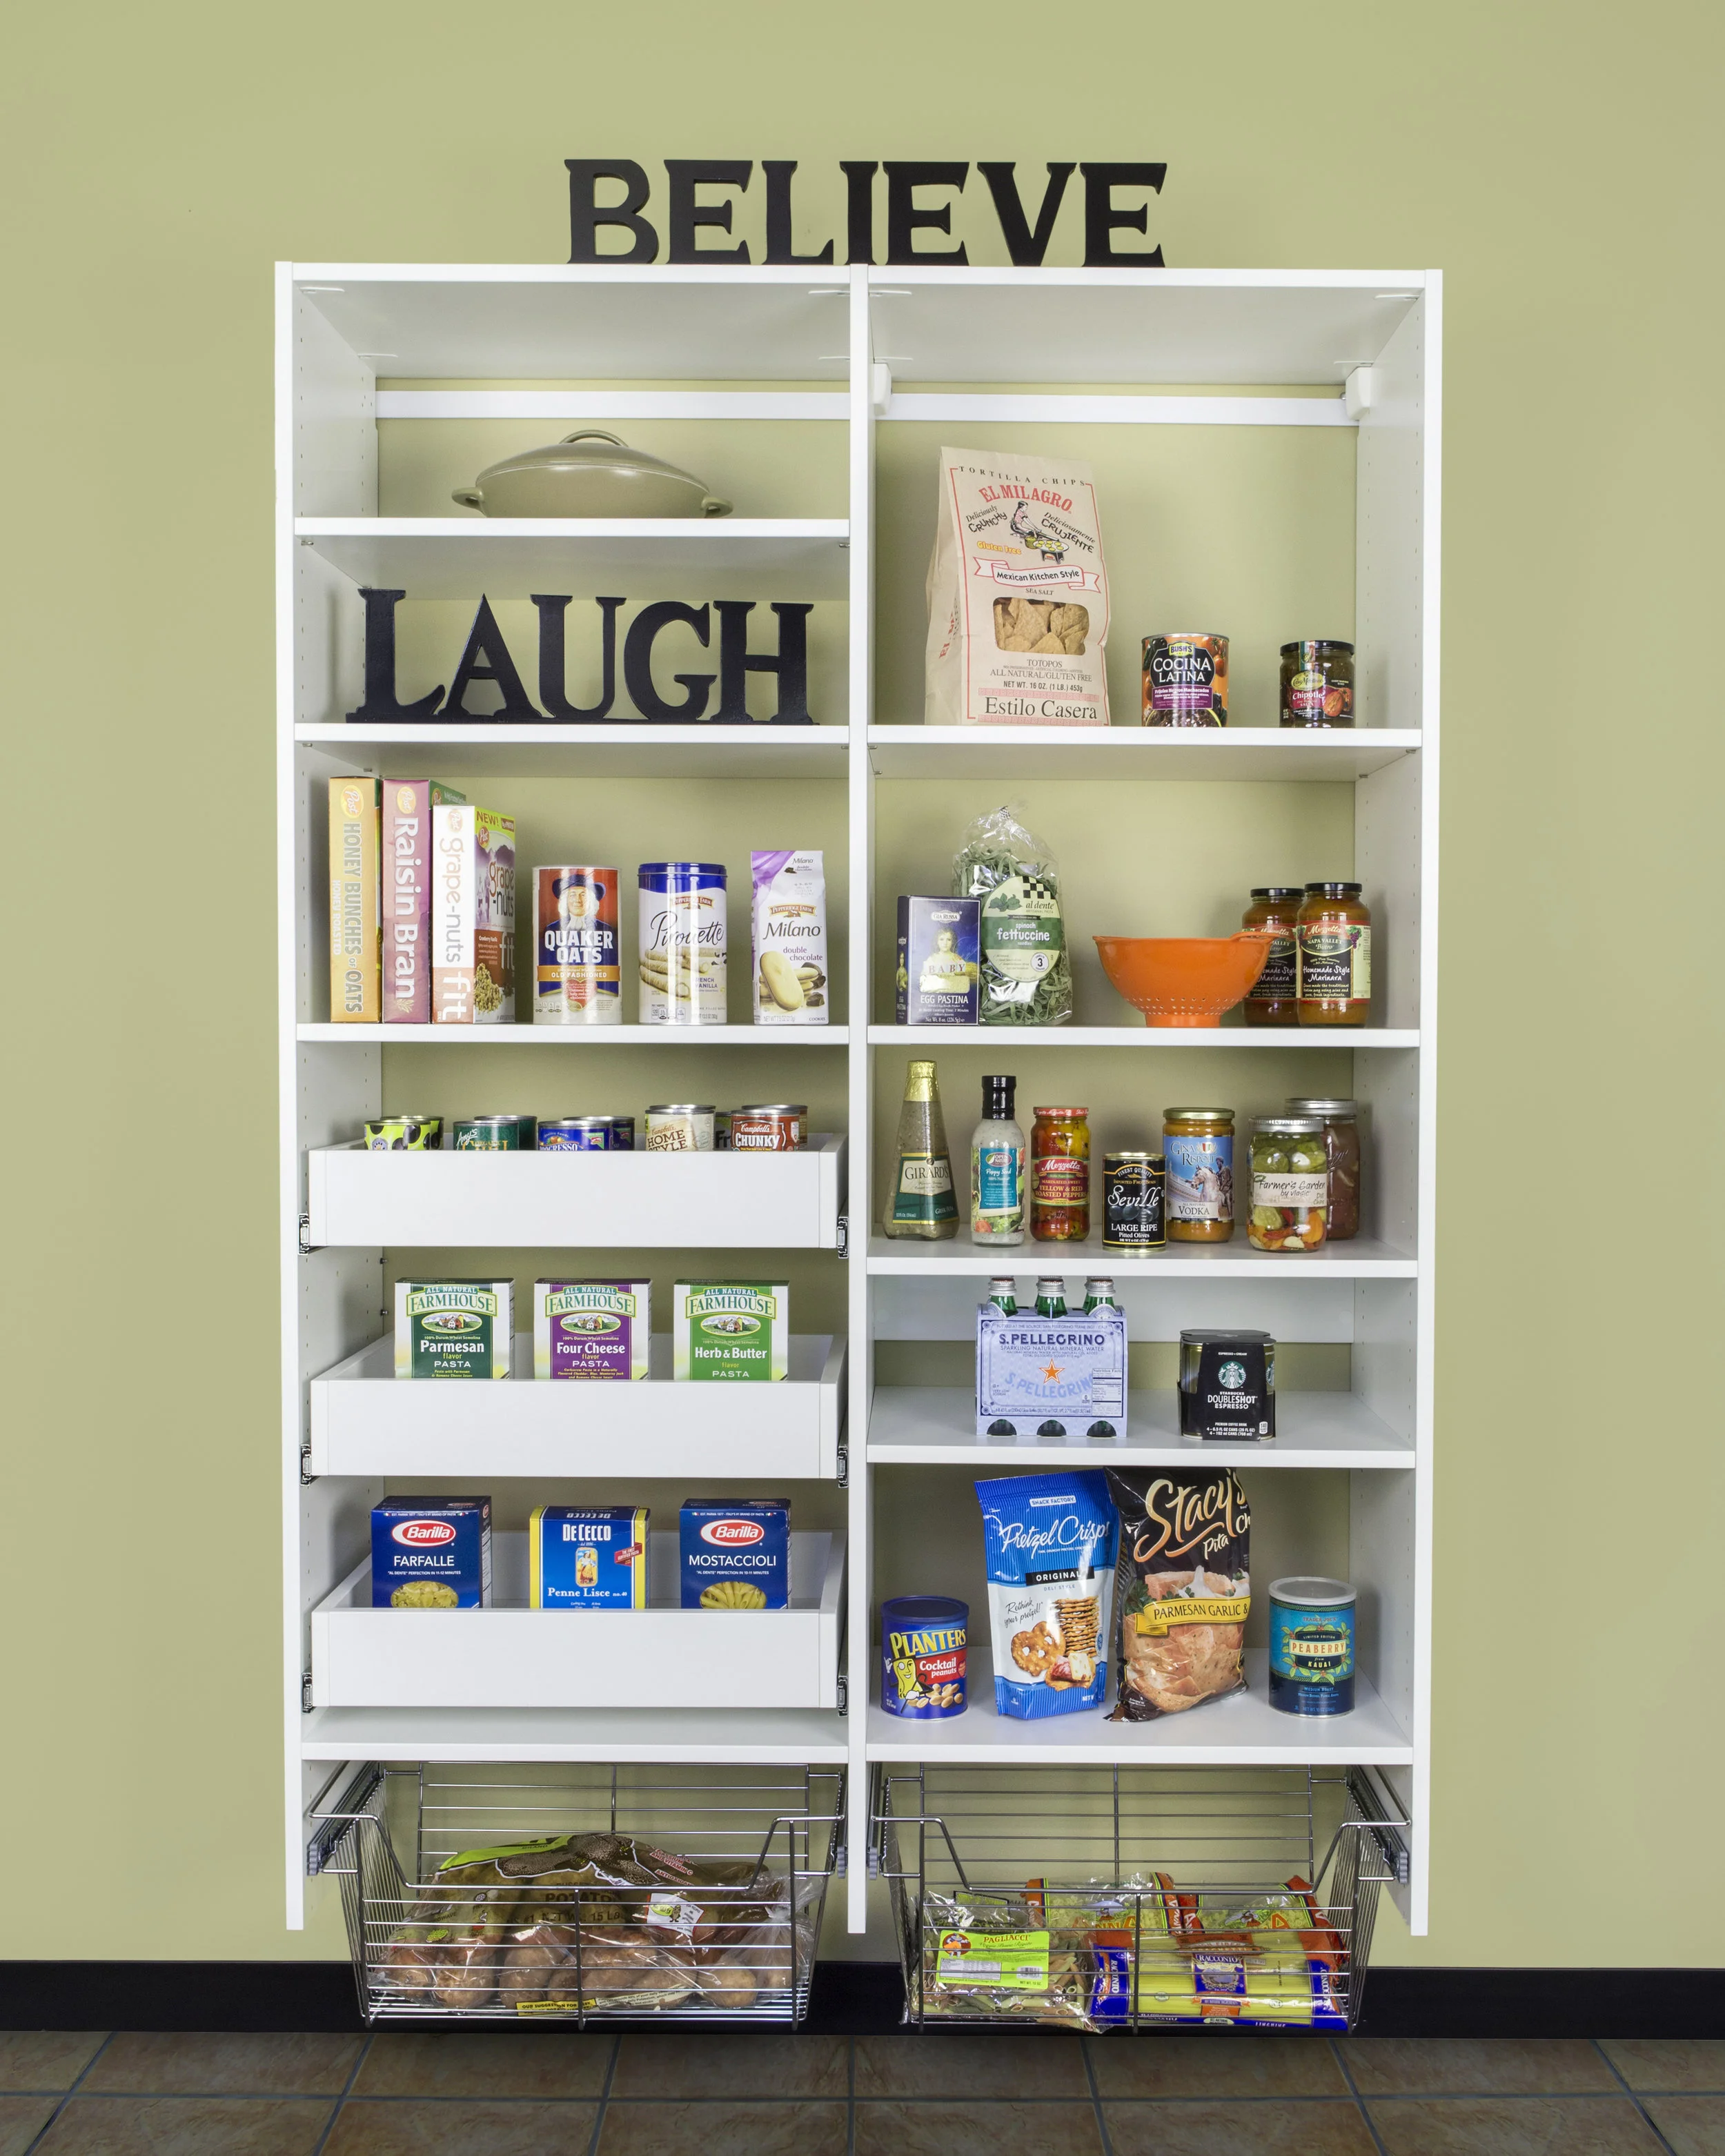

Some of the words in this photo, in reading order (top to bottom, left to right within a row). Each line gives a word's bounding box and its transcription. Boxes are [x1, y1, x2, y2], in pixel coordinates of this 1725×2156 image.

[564, 159, 1167, 266] BELIEVE
[959, 466, 1031, 483] TORTILLA
[1042, 477, 1085, 486] CHIPS
[979, 486, 1000, 503] EL
[999, 485, 1073, 512] MILAGRO
[966, 505, 998, 523] Deliciously
[968, 512, 1007, 533] CRUNCHY
[1044, 512, 1096, 543] Deliciosamente
[1041, 519, 1094, 553] CRUJIENTE
[977, 541, 1003, 551] Gluten
[1005, 546, 1021, 555] Free
[997, 572, 1028, 581] Mexican
[1029, 571, 1059, 581] Kitchen
[1061, 571, 1080, 580] Style
[346, 589, 820, 725] LAUGH
[1027, 660, 1063, 668] TOTOPOS
[1154, 657, 1212, 672] COCINA
[1159, 671, 1205, 682] LATINA
[1292, 691, 1323, 700] Chipotle
[985, 697, 1036, 715] Estilo
[1041, 700, 1097, 720] Casera
[345, 791, 360, 814] Post
[477, 811, 499, 827] NEW!
[480, 828, 489, 843] Post
[344, 822, 362, 878] HONEY
[394, 817, 422, 916] Raisin
[489, 861, 514, 897] grape
[440, 837, 465, 963] grape-nuts
[1034, 900, 1054, 909] dente
[344, 882, 363, 956] BUNCHES
[762, 921, 821, 940] Milano
[996, 927, 1050, 941] fettuccine
[1308, 924, 1343, 935] Mezzetta
[544, 930, 613, 951] QUAKER
[394, 924, 418, 999] Bran
[556, 947, 602, 963] OATS
[348, 958, 356, 968] OF
[929, 964, 965, 974] BABY
[1037, 958, 1043, 967] 3
[1303, 965, 1332, 973] Homemade
[1334, 965, 1350, 975] Style
[1308, 973, 1342, 982] Marinara
[344, 970, 363, 1013] OATS
[442, 970, 471, 1020] fit
[920, 996, 935, 1004] EGG
[937, 995, 969, 1004] PASTINA
[741, 1123, 771, 1134] Campbell's
[456, 1128, 478, 1150] Amy's
[647, 1129, 685, 1147] HOME
[736, 1132, 780, 1149] CHUNKY
[1170, 1141, 1195, 1155] GINA
[1042, 1160, 1081, 1171] Mezzetta
[1183, 1153, 1214, 1166] RISPOLI
[905, 1165, 949, 1180] GIRARD'S
[985, 1168, 1000, 1176] Poppy
[1118, 1167, 1132, 1178] FINEST
[1134, 1167, 1153, 1178] QUALITY
[1259, 1180, 1297, 1190] Farmer's
[1298, 1180, 1325, 1190] Garden
[1107, 1185, 1161, 1207] Seville
[1179, 1206, 1210, 1215] VODKA
[1112, 1223, 1138, 1232] LARGE
[411, 1294, 494, 1312] FARMHOUSE
[549, 1294, 633, 1314] FARMHOUSE
[690, 1296, 773, 1315] FARMHOUSE
[420, 1340, 484, 1352] Parmesan
[999, 1334, 1105, 1345] S.PELLEGRINO
[557, 1342, 582, 1354] Four
[584, 1343, 625, 1354] Cheese
[695, 1347, 721, 1358] Herb
[722, 1349, 730, 1358] &
[732, 1347, 767, 1359] Butter
[1208, 1395, 1256, 1403] DOUBLESHOT
[1032, 1498, 1049, 1506] SNACK
[1049, 1496, 1074, 1505] FACTORY
[1134, 1468, 1246, 1563] Stacy's
[406, 1526, 451, 1539] Barilla
[562, 1524, 577, 1541] DE
[578, 1524, 611, 1541] CECCO
[716, 1526, 759, 1538] Barilla
[999, 1519, 1058, 1559] Pretzel
[1203, 1533, 1229, 1559] Pita
[394, 1555, 455, 1567] FARFALLE
[689, 1554, 776, 1566] MOSTACCIOLI
[1036, 1571, 1081, 1581] ORIGINAL
[547, 1588, 580, 1596] Penne
[583, 1588, 610, 1596] Lisce
[1005, 1597, 1034, 1615] Rethink
[1154, 1603, 1206, 1620] PARMESAN
[1208, 1602, 1241, 1616] GARLIC
[1004, 1614, 1018, 1628] your
[889, 1628, 966, 1658] PLANTERS
[1291, 1642, 1345, 1654] PEABERRY
[919, 1657, 956, 1671] Cocktail
[931, 1668, 957, 1678] peanuts
[650, 1851, 663, 1861] AND
[663, 1855, 688, 1872] VITAMIN
[591, 1912, 603, 1921] 15
[984, 1935, 1029, 1943] PAGLIACCI
[1199, 1955, 1238, 1963] RACCONTO
